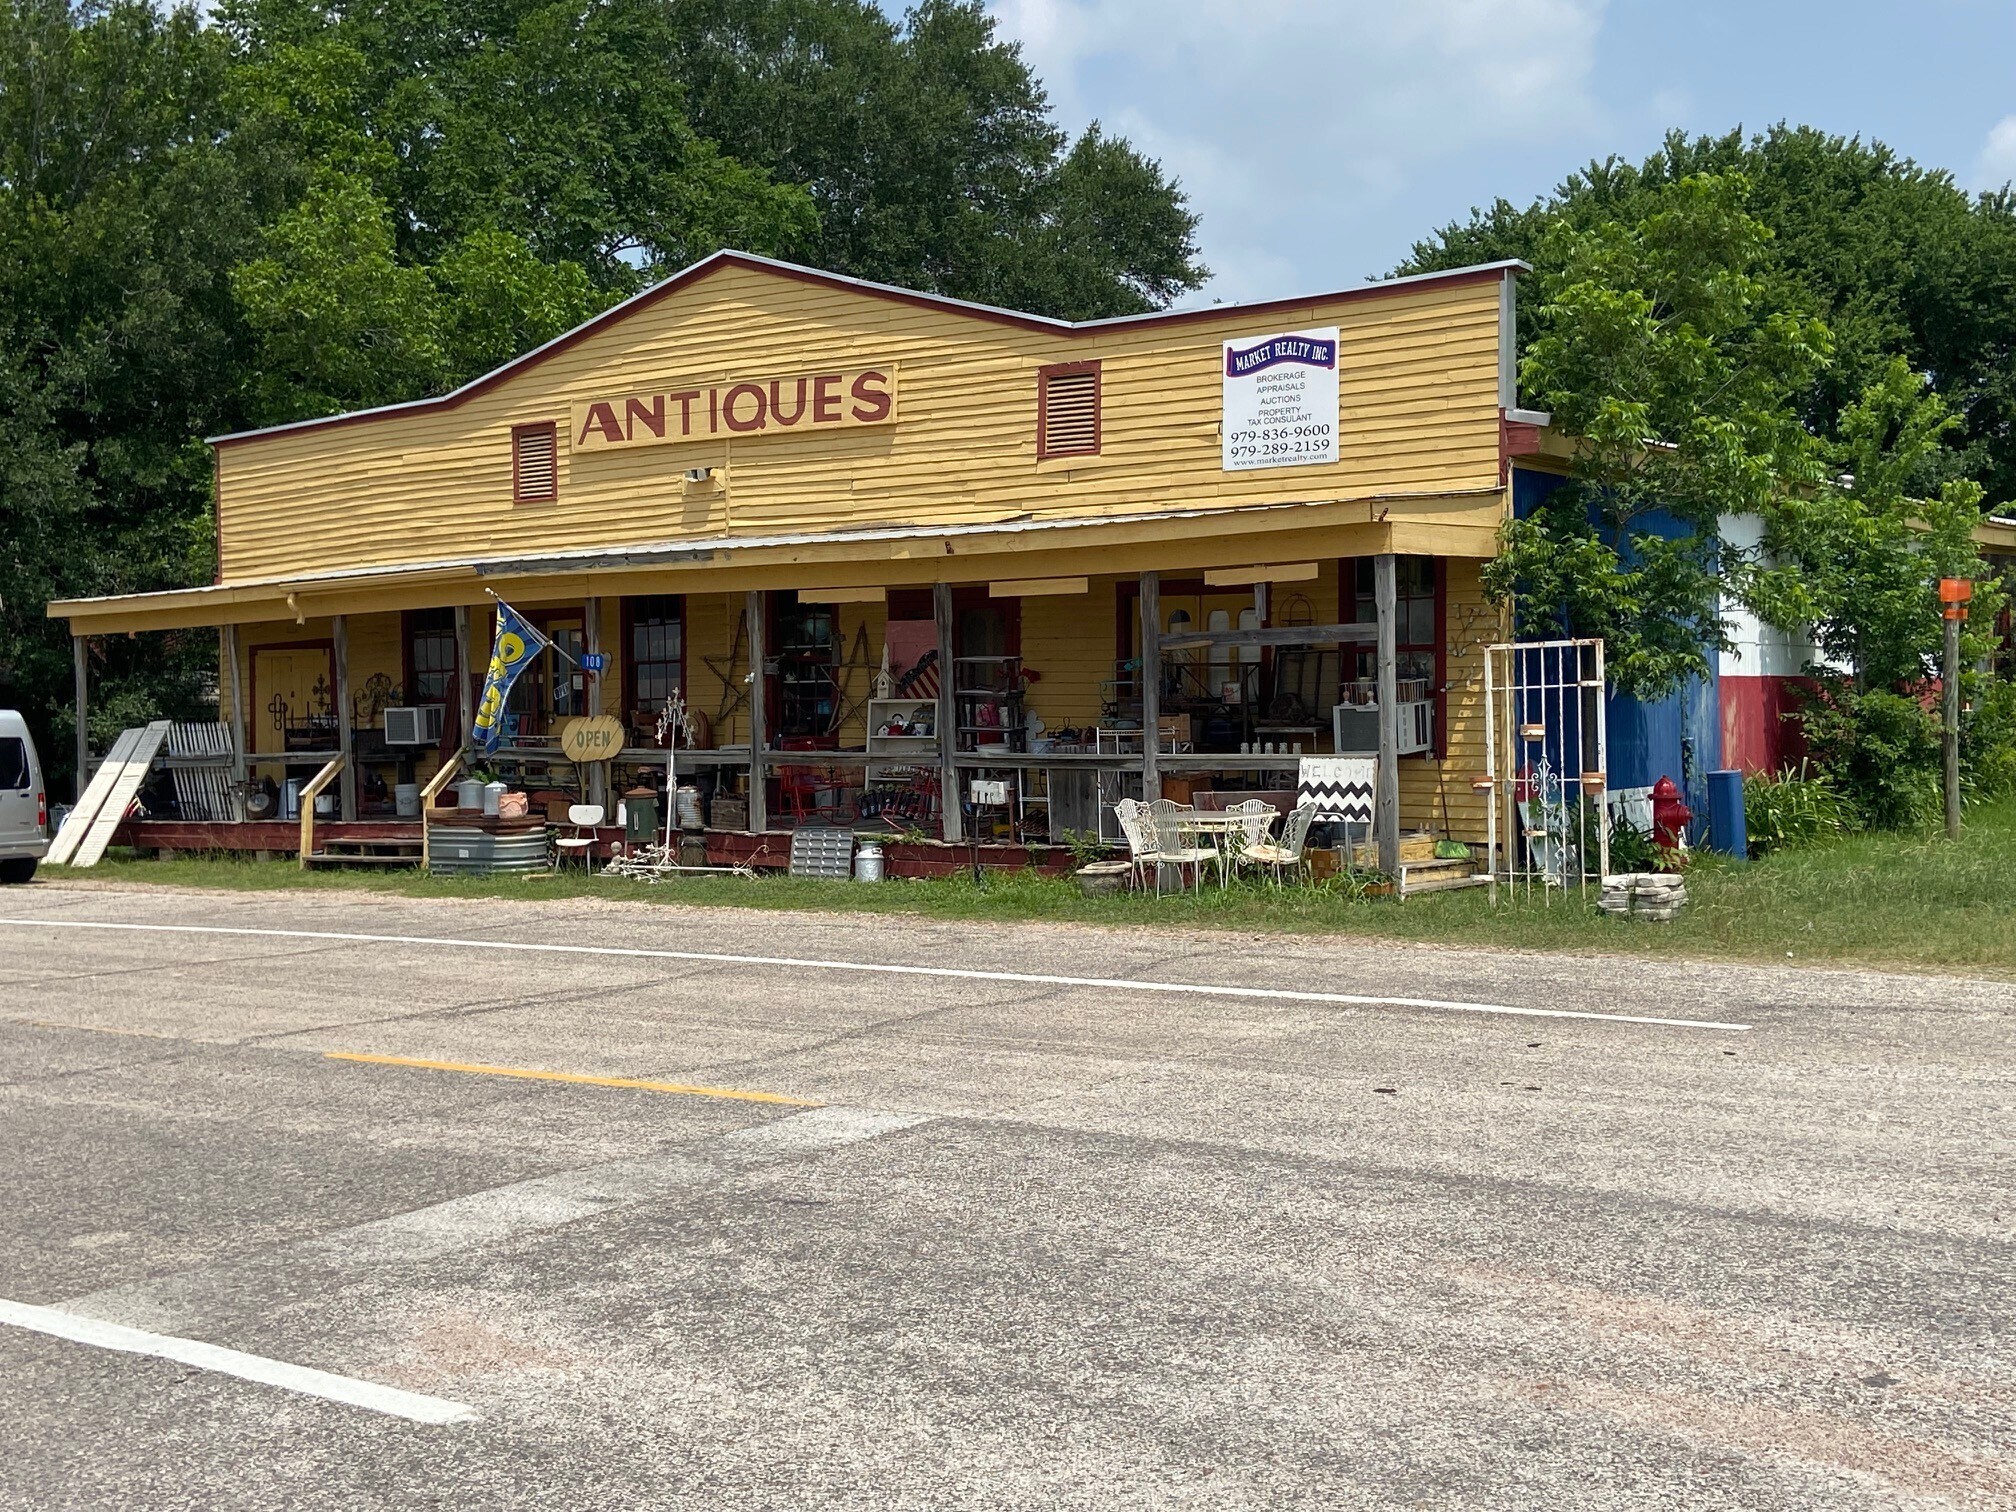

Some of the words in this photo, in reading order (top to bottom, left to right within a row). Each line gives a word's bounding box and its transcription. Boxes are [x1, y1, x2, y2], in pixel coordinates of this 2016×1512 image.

[1235, 345, 1271, 371] MARKET
[1274, 341, 1310, 357] REALTY
[1312, 345, 1329, 360] INC.
[1256, 371, 1306, 383] BROKERAGE
[1256, 382, 1306, 394] APPRAISALS
[1260, 394, 1301, 405] AUCTIONS
[577, 371, 891, 445] ANTIQUES
[1258, 406, 1301, 417] PROPERTY
[1247, 418, 1262, 426] TAX
[1263, 413, 1313, 425] CONSULANT
[1230, 424, 1330, 444] 979-836-9600
[1230, 439, 1330, 458] 979-289-2159
[1233, 453, 1328, 467] www.marketrealty.com
[585, 656, 601, 668] 108
[576, 730, 611, 748] OPEN
